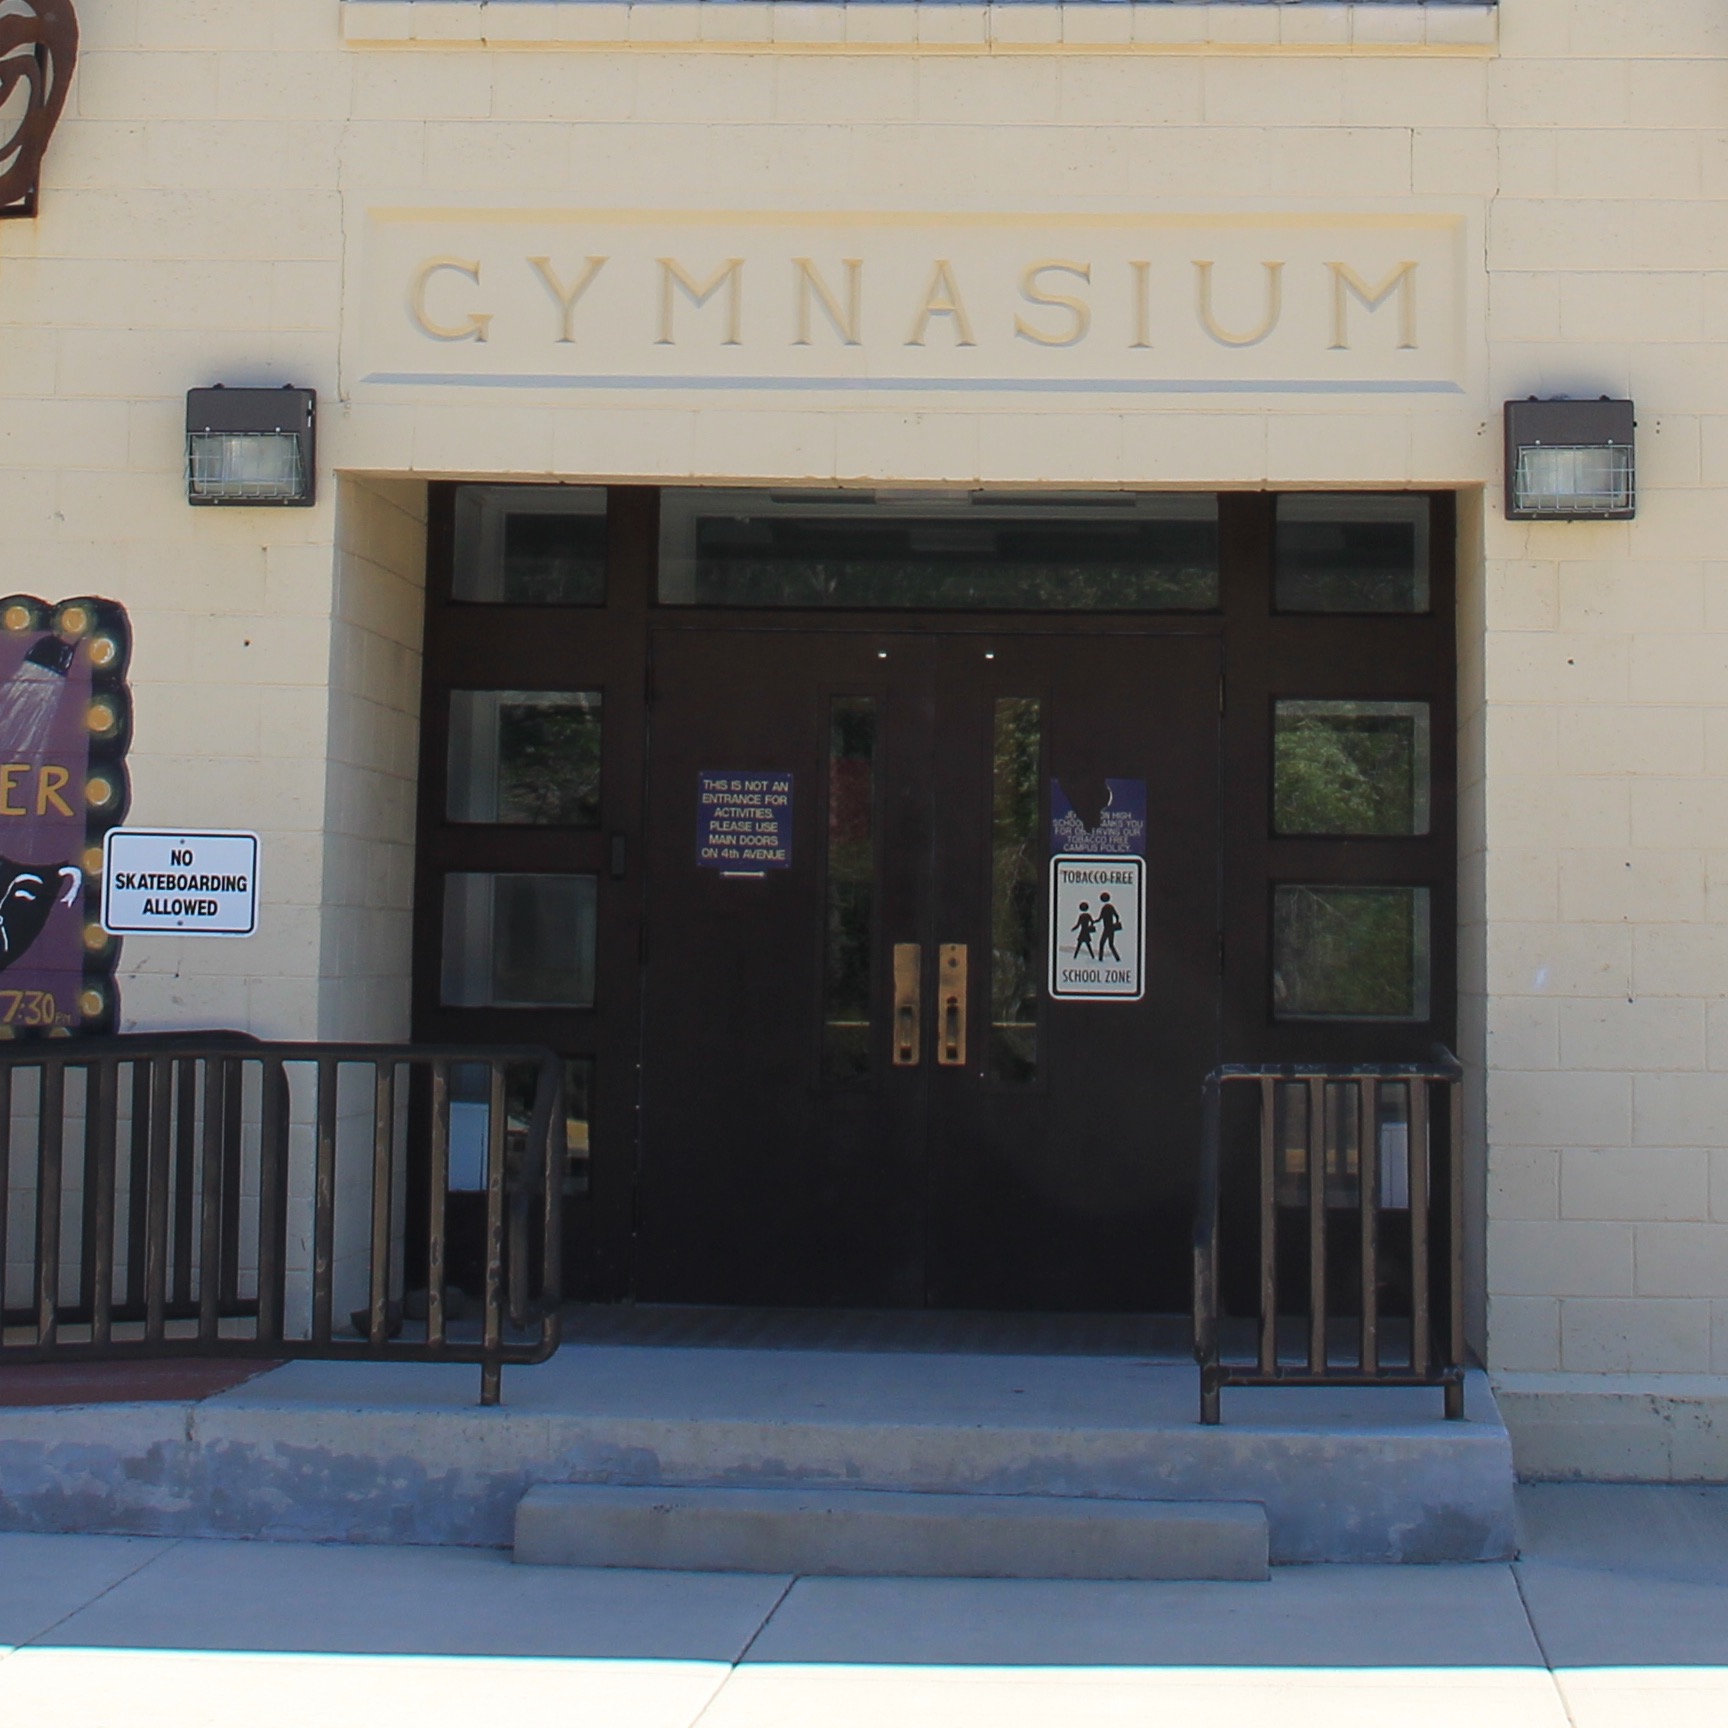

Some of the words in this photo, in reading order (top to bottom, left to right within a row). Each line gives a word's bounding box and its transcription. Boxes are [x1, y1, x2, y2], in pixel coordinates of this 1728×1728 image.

[408, 255, 1419, 351] GYMNASIUM
[703, 779, 728, 790] THIS
[731, 780, 742, 791] IS
[745, 780, 769, 791] NOT
[772, 781, 789, 792] AN
[702, 793, 761, 805] ENTRANCE
[764, 794, 788, 805] FOR
[1112, 811, 1132, 821] HIGH
[709, 820, 752, 832] PLEASE
[755, 821, 778, 833] USE
[1126, 820, 1144, 828] YOU
[708, 834, 737, 845] MAIN
[739, 835, 778, 846] DOORS
[1067, 835, 1107, 844] TOBACCO
[1109, 835, 1129, 844] FREE
[701, 847, 718, 858] ON
[721, 848, 740, 859] 4th
[742, 849, 786, 860] AVENUE
[1063, 843, 1098, 852] CAMPUS
[171, 849, 194, 867] NO
[115, 872, 248, 893] SKATEBOARDING
[1062, 870, 1134, 885] TOBACCO-FREE
[142, 898, 218, 917] ALLOWED
[1062, 969, 1101, 984] SCHOOL
[1105, 969, 1132, 984] ZONE
